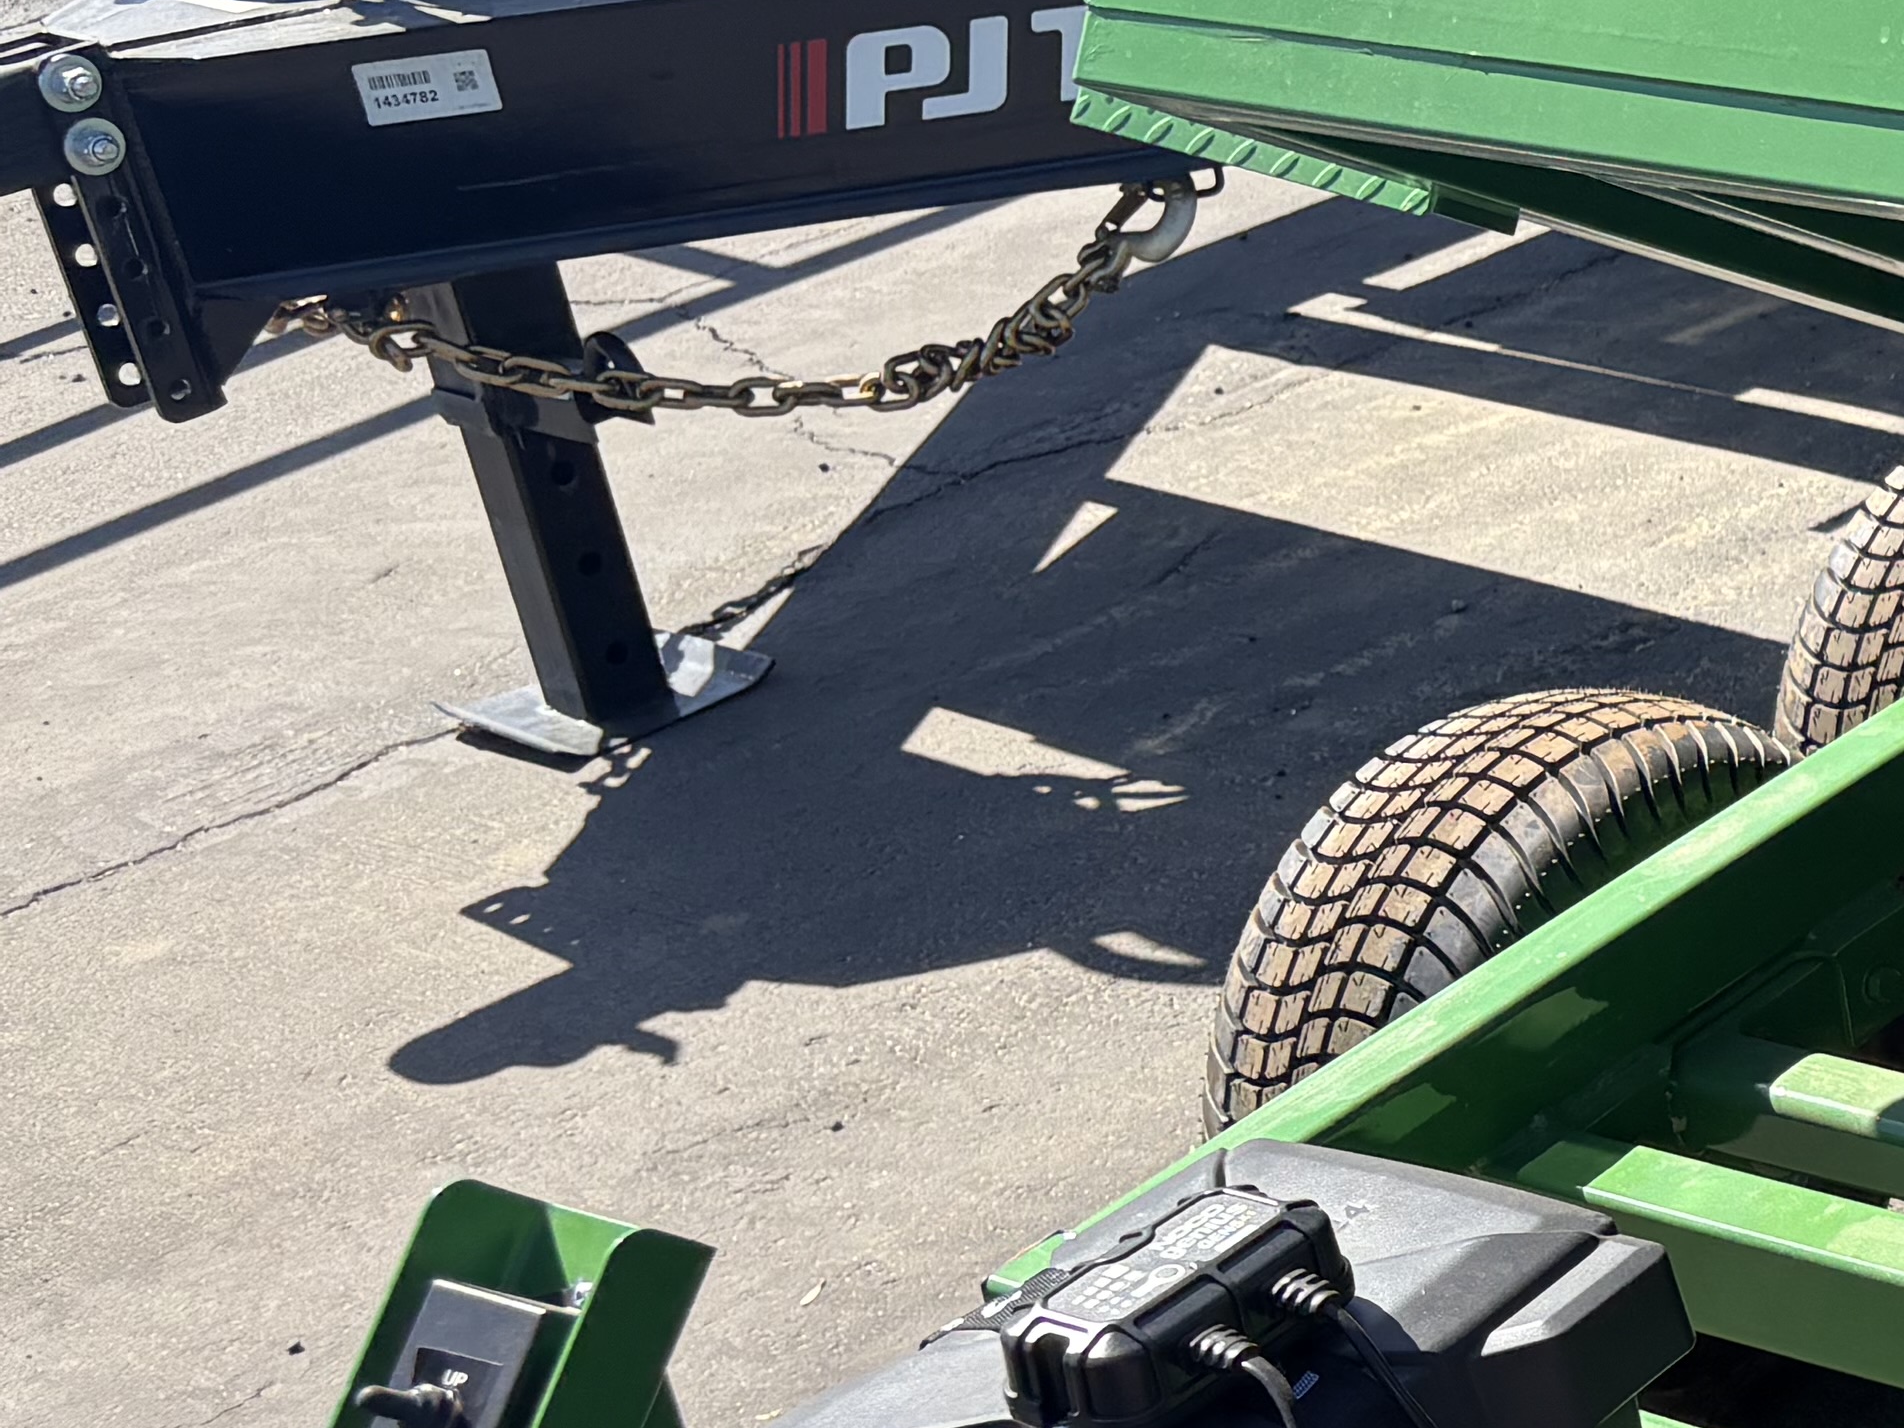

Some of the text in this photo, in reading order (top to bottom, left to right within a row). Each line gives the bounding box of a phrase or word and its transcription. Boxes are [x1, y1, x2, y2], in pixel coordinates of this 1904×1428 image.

[846, 16, 1008, 130] PJ
[374, 90, 439, 109] 1434782
[441, 1369, 469, 1388] UP
